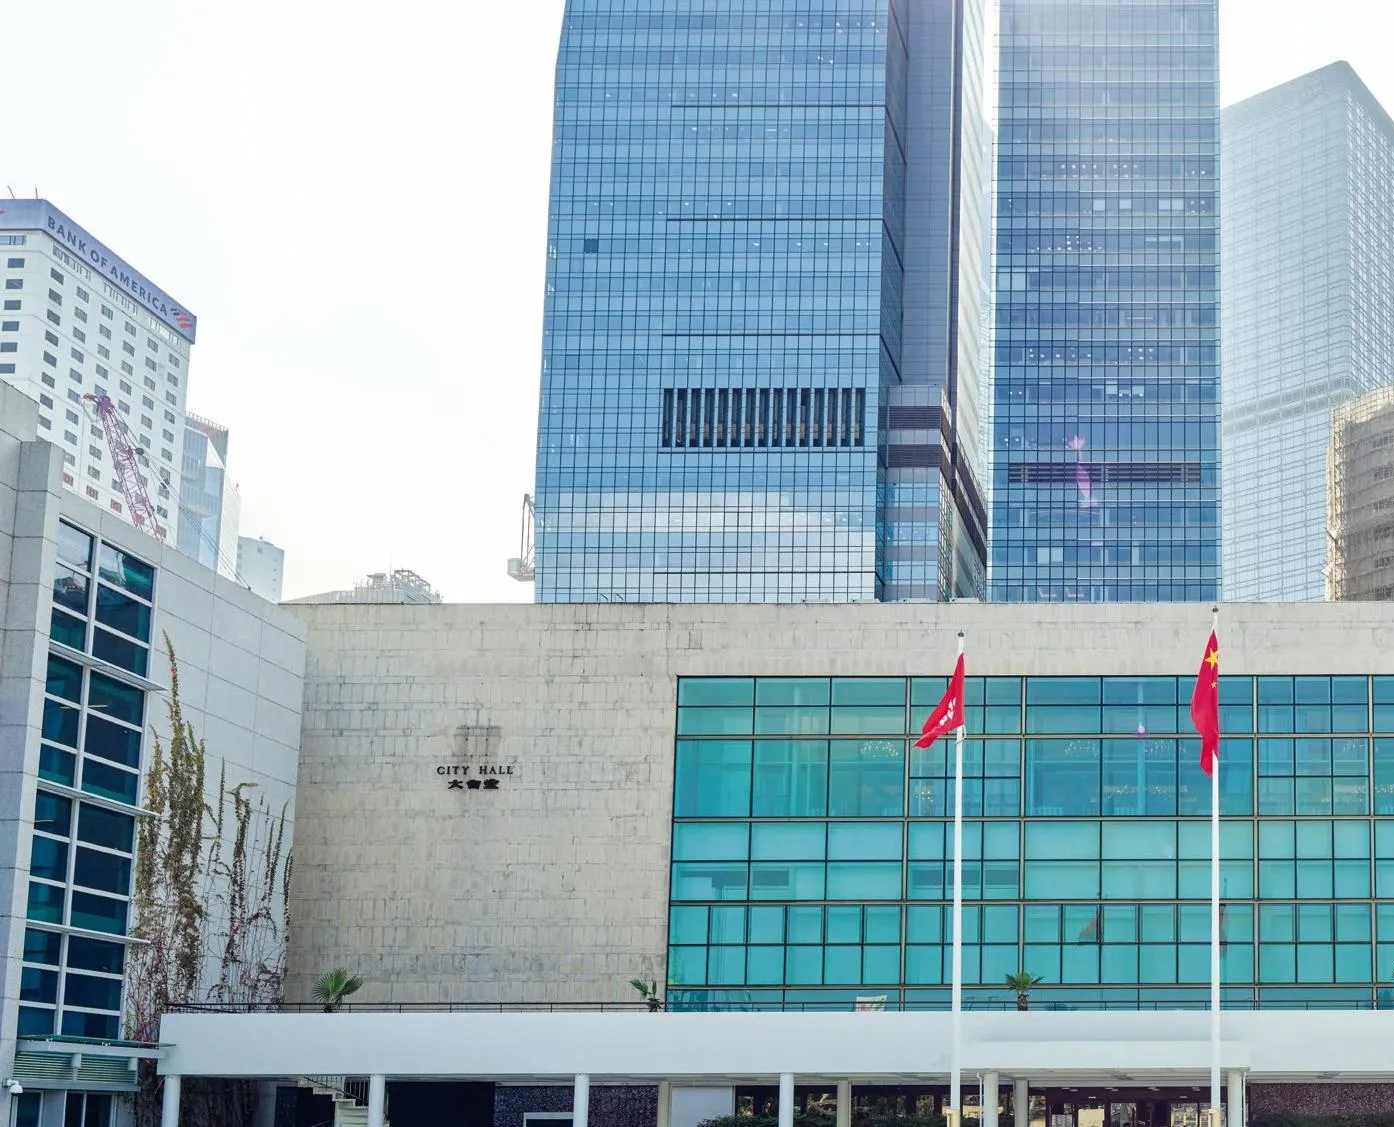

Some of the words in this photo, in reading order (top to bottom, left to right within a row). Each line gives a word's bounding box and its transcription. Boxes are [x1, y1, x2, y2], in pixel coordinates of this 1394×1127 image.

[47, 215, 87, 256] BANK
[90, 249, 108, 268] OF
[110, 265, 168, 316] AMERICA
[436, 765, 470, 775] CITY
[479, 765, 514, 775] HALL
